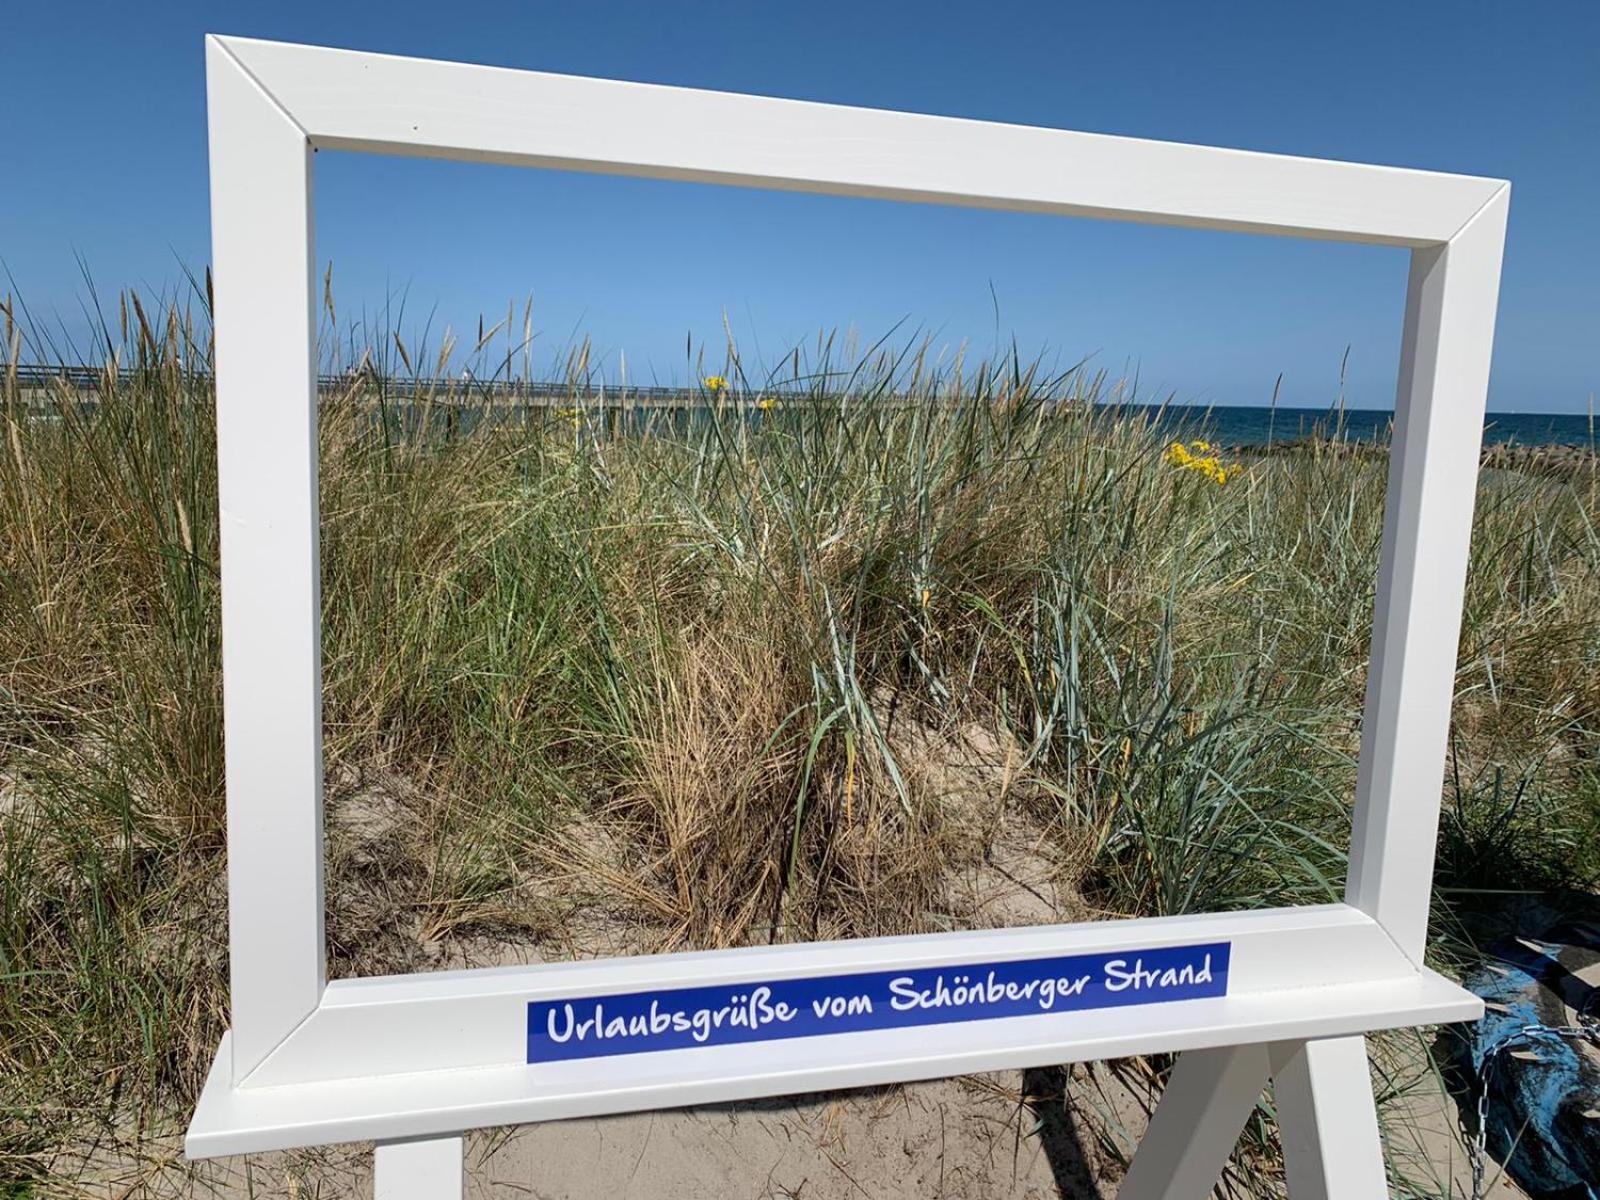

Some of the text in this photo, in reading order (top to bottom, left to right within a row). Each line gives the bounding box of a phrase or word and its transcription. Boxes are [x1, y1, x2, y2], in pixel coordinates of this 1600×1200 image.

[547, 953, 1213, 1043] Urlaubsgrüße vom Schönberger Strand
